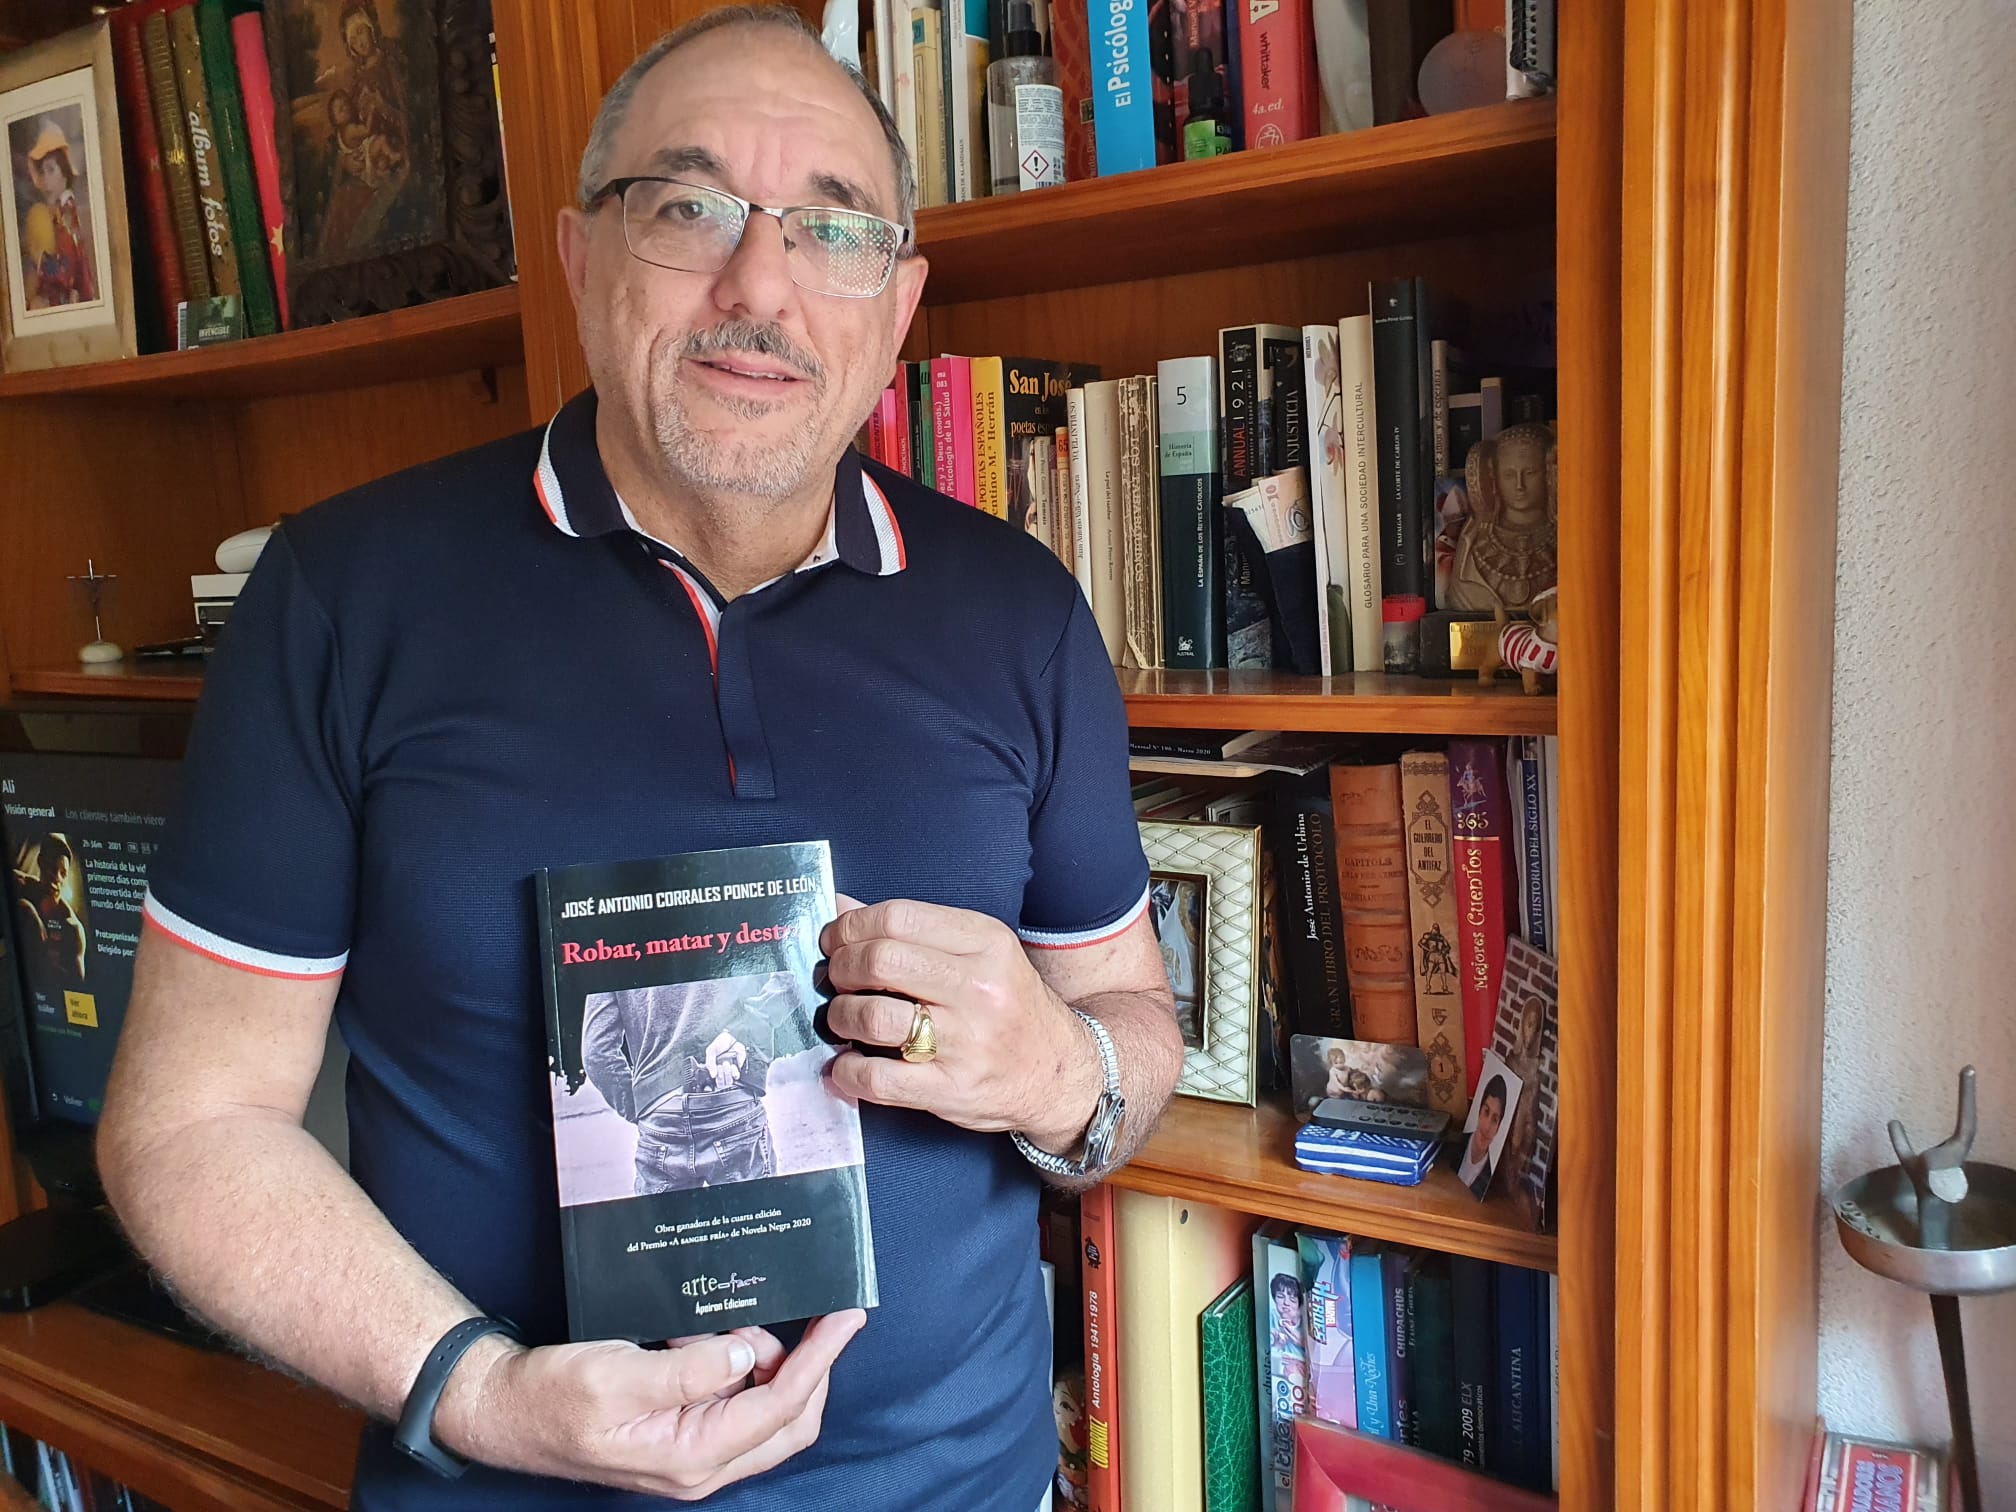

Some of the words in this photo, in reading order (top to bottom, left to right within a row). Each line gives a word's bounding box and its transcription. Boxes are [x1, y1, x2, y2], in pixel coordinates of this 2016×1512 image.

[1189, 9, 1200, 48] Manuel
[1104, 0, 1134, 93] Psicólog
[1259, 31, 1272, 90] whittaker
[1113, 90, 1132, 108] El
[1252, 98, 1285, 115] 4a.ed.
[188, 110, 212, 187] album
[200, 194, 226, 257] fotos
[1009, 369, 1039, 395] San
[1041, 372, 1073, 402] José
[1176, 385, 1187, 405] 5
[934, 400, 943, 438] (coords.)
[942, 391, 951, 417] Salud
[986, 391, 996, 441] Herrán
[1354, 381, 1366, 458] INTERCULTURAL
[943, 419, 952, 429] la
[943, 431, 952, 443] de
[975, 391, 986, 457] ESPAÑOLES
[1010, 420, 1037, 438] poetas
[1286, 388, 1300, 463] INJUSTICIA
[936, 441, 944, 462] Deus
[1232, 422, 1246, 478] ANNUAL
[937, 463, 945, 473] J.
[976, 460, 987, 503] POETAS
[988, 471, 999, 516] entino
[1357, 460, 1369, 510] SOCIEDAD
[1359, 512, 1370, 533] UNA
[1360, 535, 1371, 560] PARA
[1362, 561, 1374, 609] GLOSARIO
[2, 779, 15, 794] Ali
[1526, 773, 1537, 791] XX
[4, 803, 27, 816] Visión
[27, 805, 55, 819] general
[1424, 819, 1433, 831] EL
[1295, 813, 1308, 853] Urbina
[1530, 836, 1540, 858] DEL
[94, 859, 118, 871] historia
[119, 861, 128, 871] de
[1299, 854, 1310, 869] de
[1310, 812, 1329, 905] PROTOCOLO
[1417, 860, 1442, 872] ANTIFAZ
[1423, 846, 1435, 858] DEL
[561, 897, 595, 919] JOSÉ
[598, 893, 654, 915] ANTONIO
[656, 886, 721, 909] CORRALES
[724, 881, 765, 902] PONCE
[768, 880, 785, 897] DE
[786, 876, 817, 895] LEÓN
[1303, 870, 1315, 916] Antonio
[1531, 861, 1542, 917] HISTORIA
[1306, 918, 1320, 941] José
[1321, 911, 1333, 936] DEL
[1533, 921, 1543, 935] LA
[562, 938, 641, 966] Robar,
[646, 932, 713, 956] matar
[717, 931, 732, 954] y
[1324, 939, 1338, 983] LIBRO
[1471, 931, 1489, 992] Mejores
[627, 1242, 640, 1253] del
[641, 1239, 668, 1252] Premio
[730, 1228, 740, 1239] de
[741, 1224, 768, 1236] Novela
[769, 1221, 791, 1234] Negra
[792, 1217, 812, 1229] 2020
[654, 1222, 676, 1234] Obra
[676, 1219, 711, 1233] ganadora
[712, 1216, 722, 1227] de
[722, 1215, 730, 1225] la
[731, 1213, 754, 1224] cuarta
[755, 1207, 782, 1220] edición
[723, 1296, 757, 1311] Ediciones
[1088, 1289, 1099, 1349] 1941-1978
[1311, 1280, 1343, 1345] HEROES
[1276, 1379, 1291, 1468] cuerpo
[1461, 1407, 1474, 1440] 2009
[1280, 1471, 1290, 1488] el
